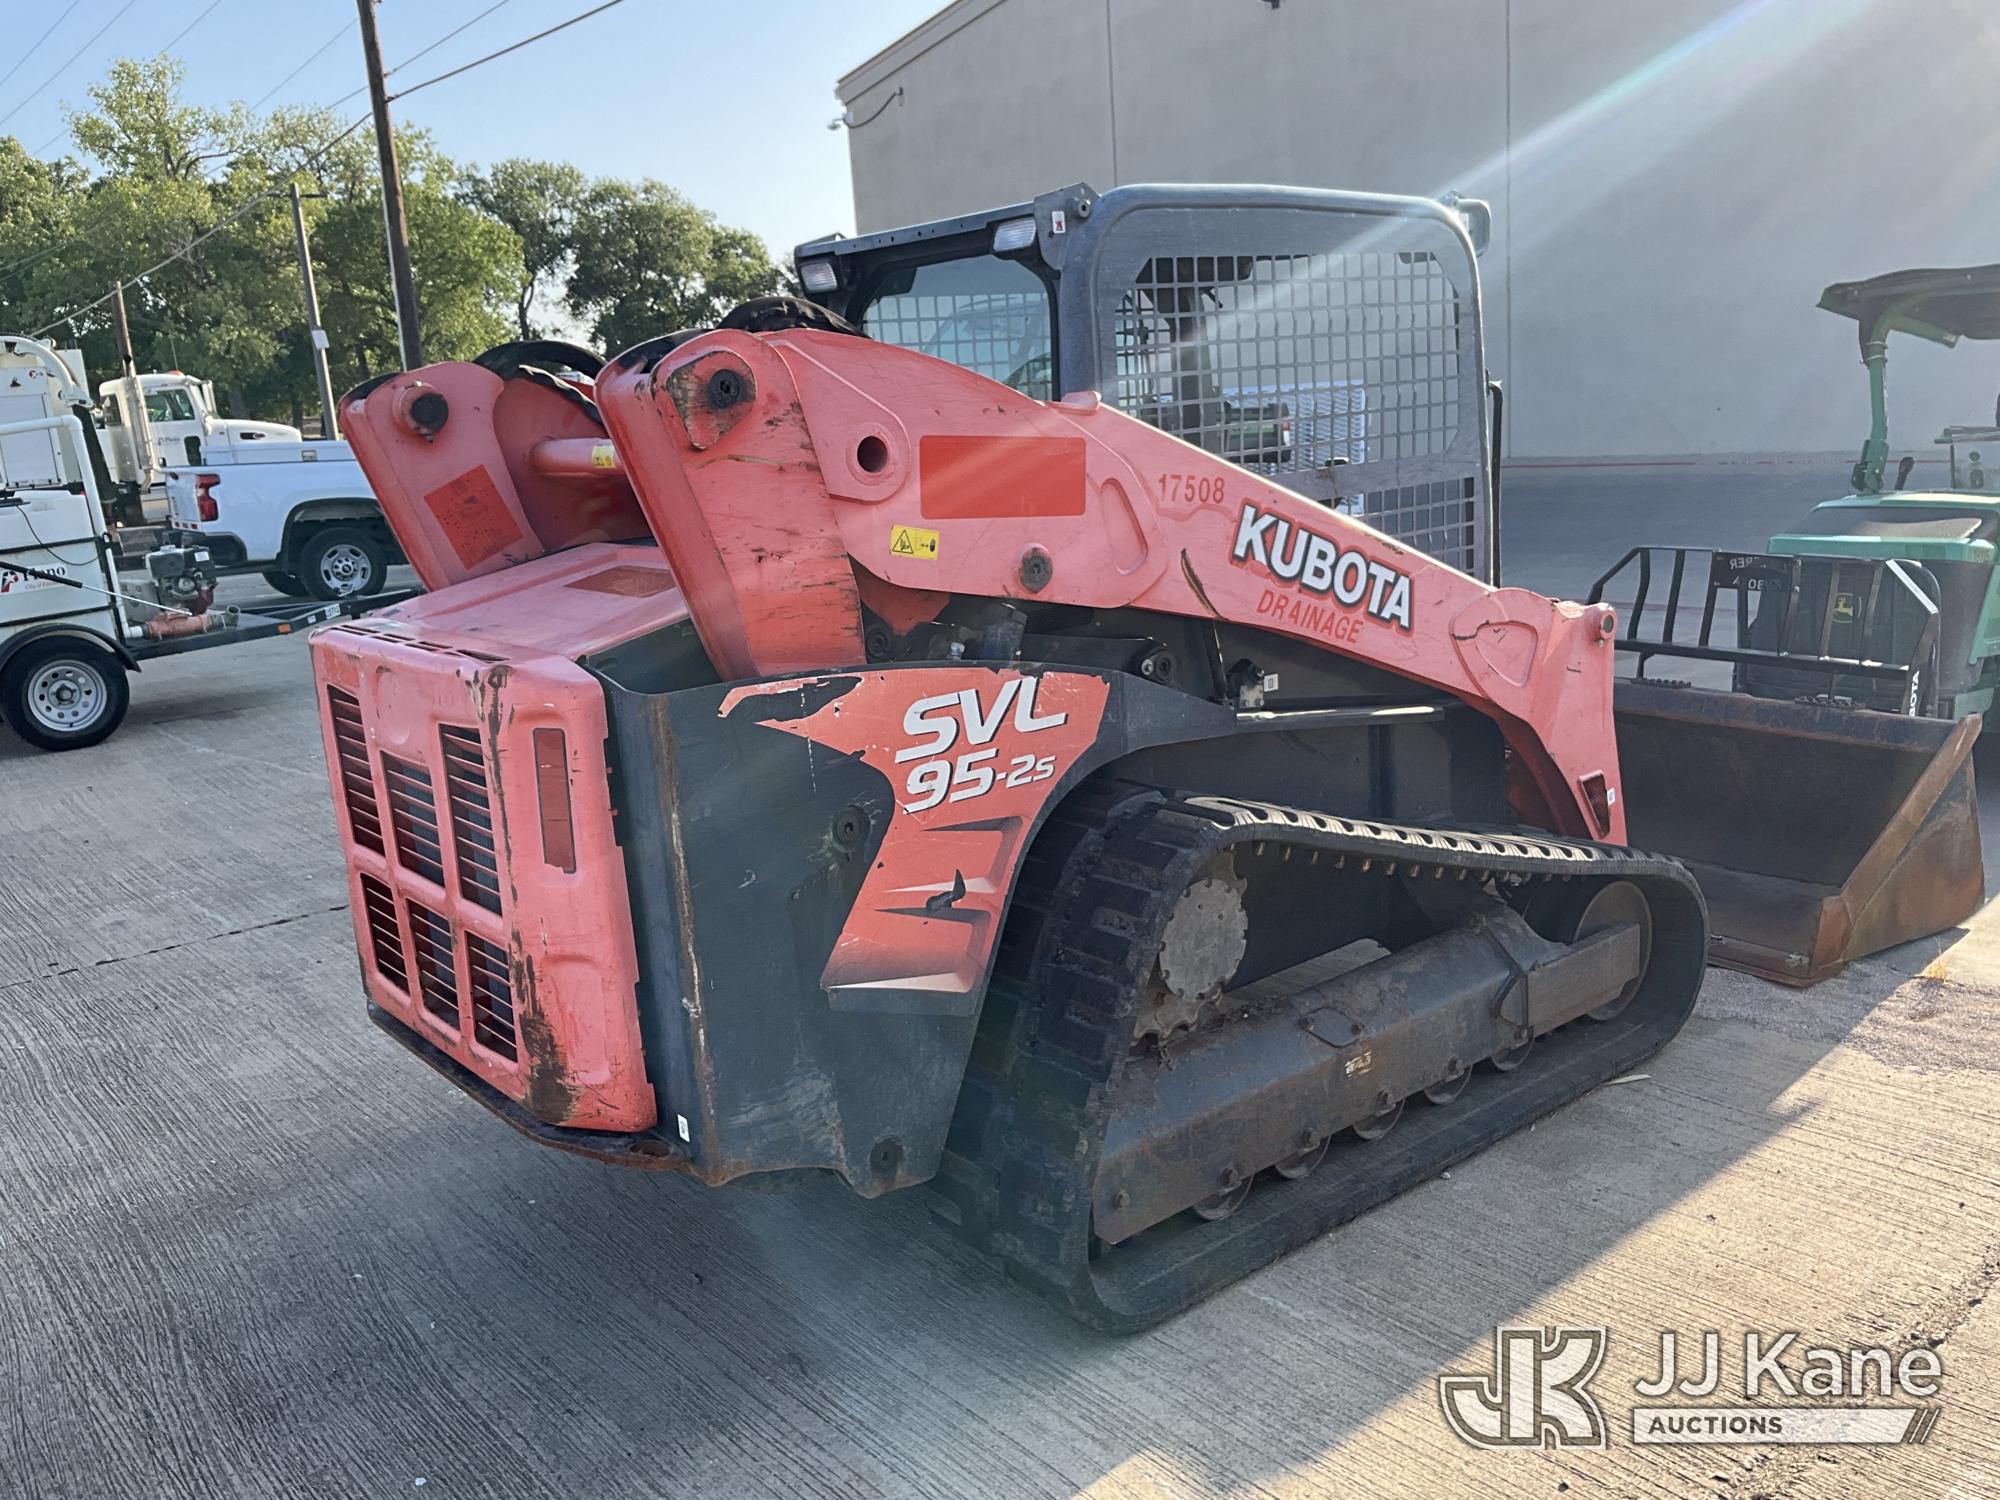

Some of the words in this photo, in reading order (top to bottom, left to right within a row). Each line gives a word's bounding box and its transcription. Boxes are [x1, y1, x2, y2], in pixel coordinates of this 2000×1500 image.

[1158, 474, 1225, 504] 17508
[1232, 503, 1413, 631] KUBOTA
[1256, 589, 1364, 643] DRAINAGE
[894, 676, 1069, 764] SVL
